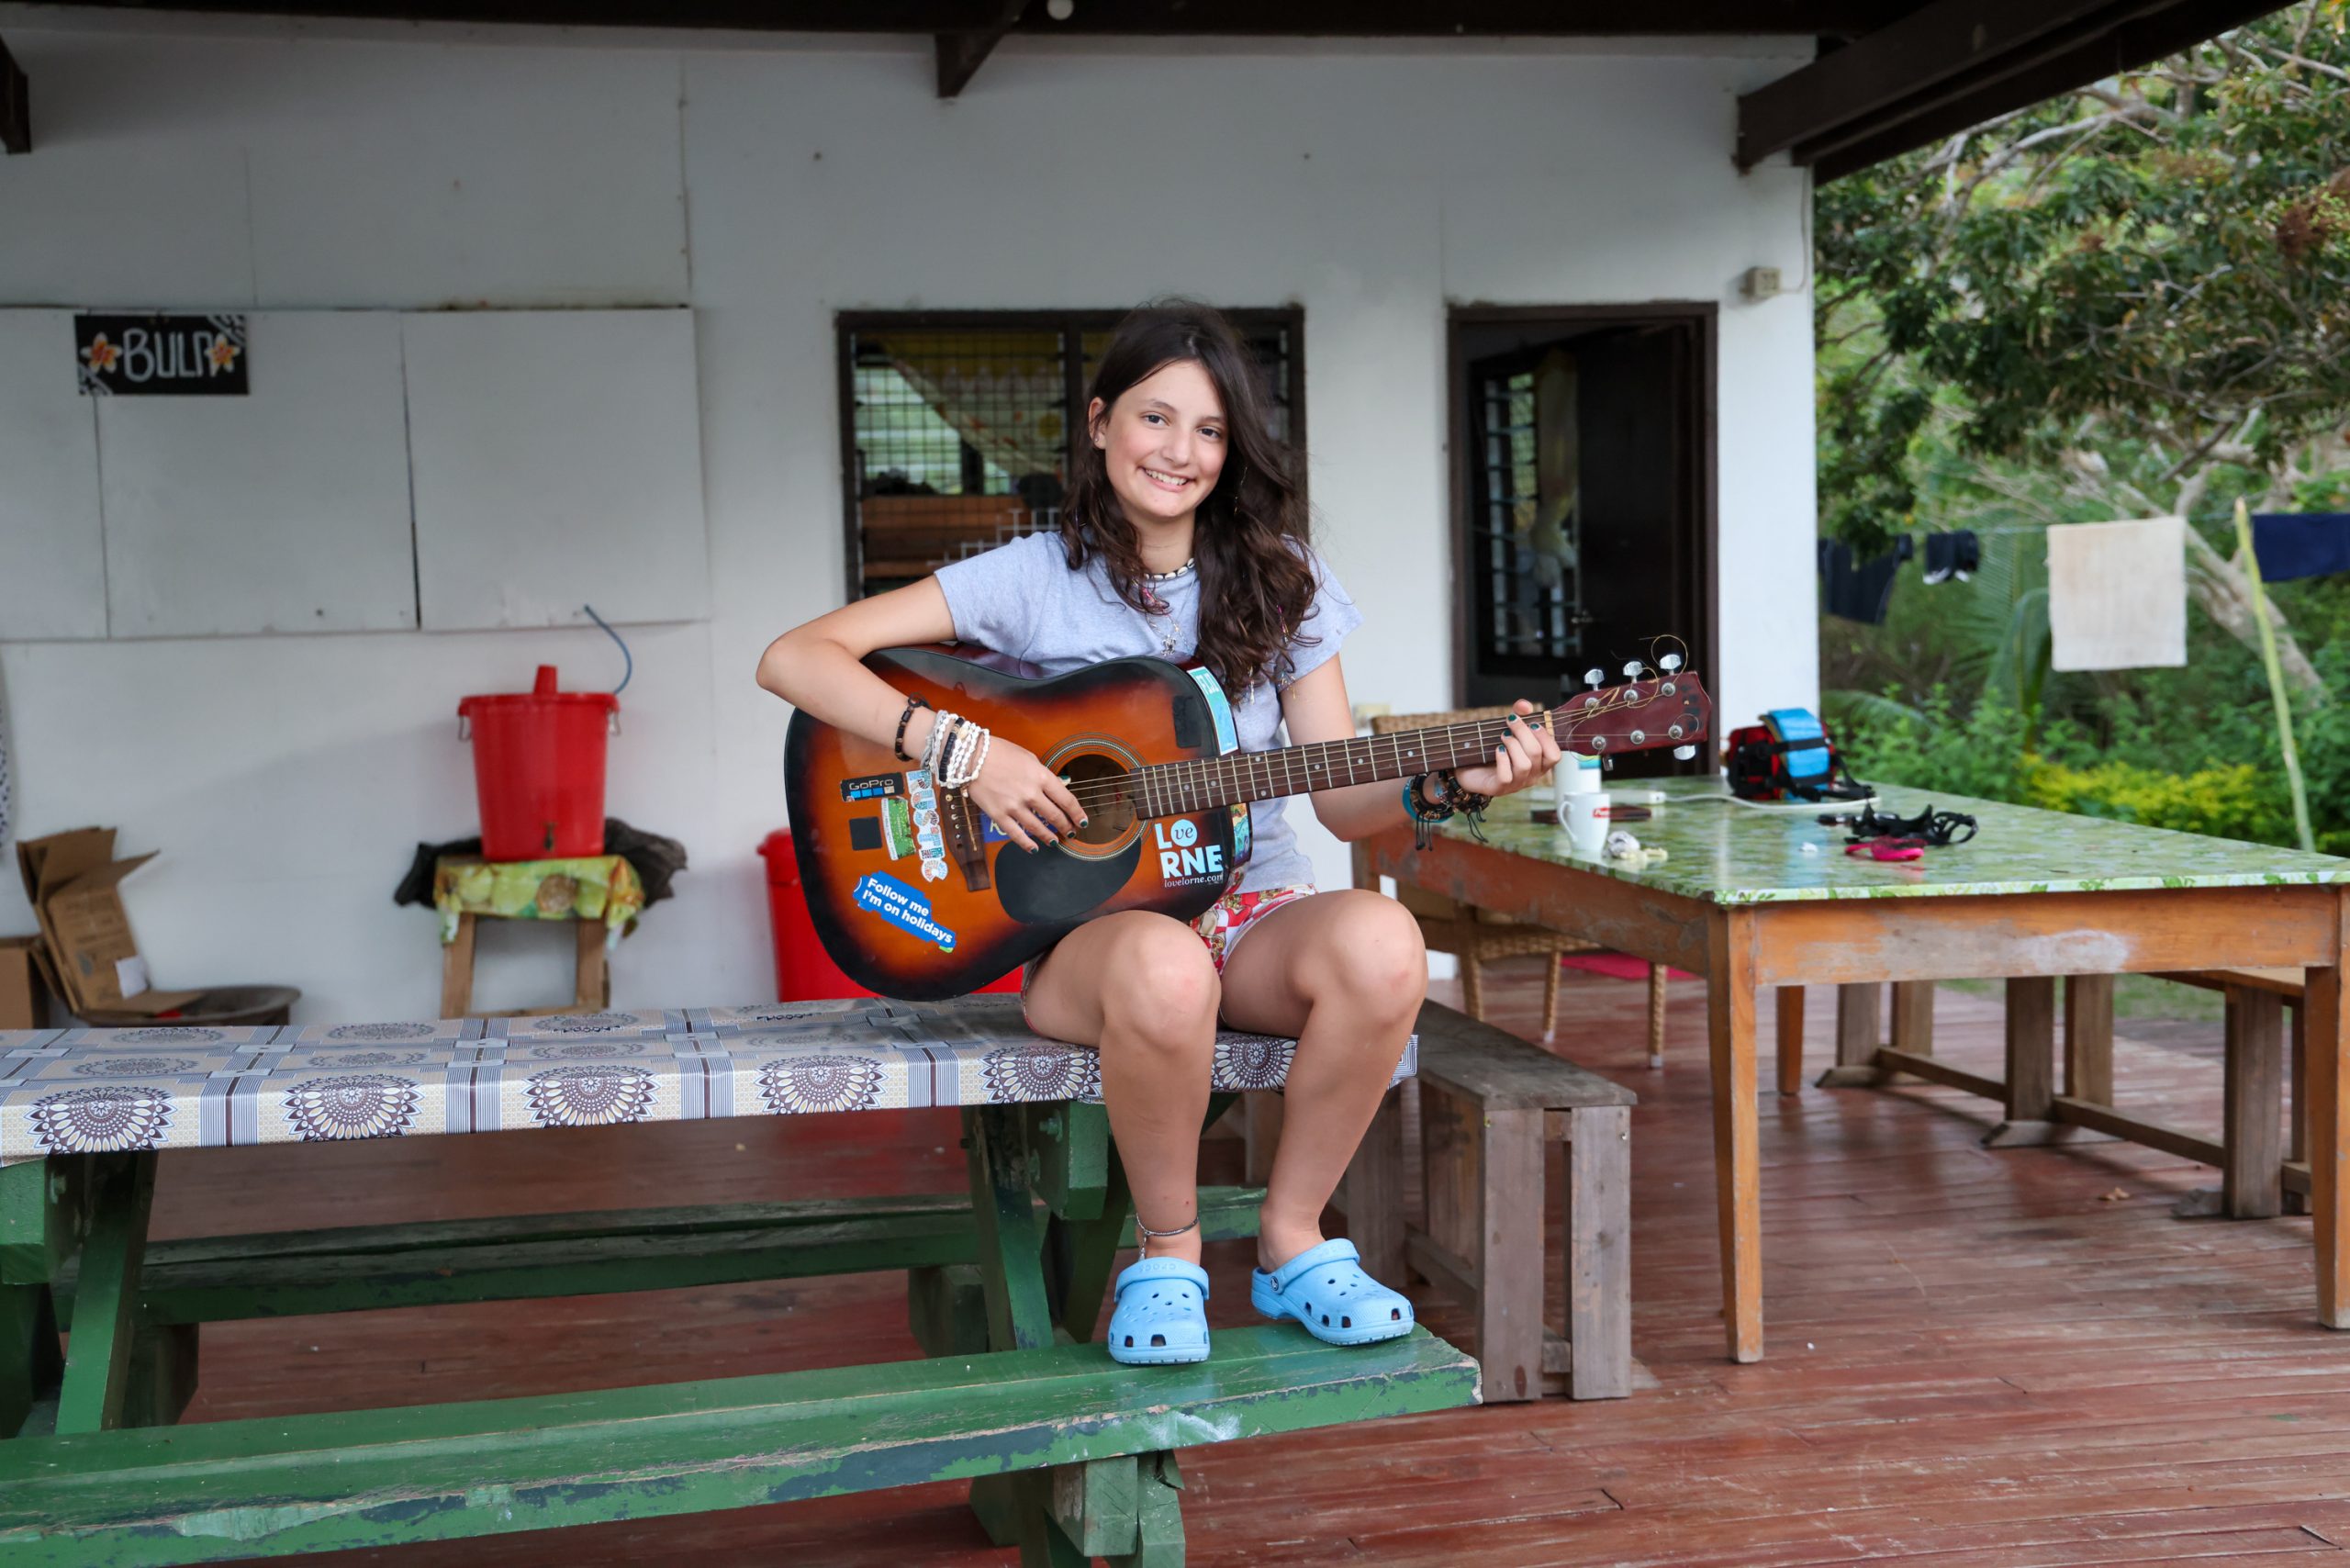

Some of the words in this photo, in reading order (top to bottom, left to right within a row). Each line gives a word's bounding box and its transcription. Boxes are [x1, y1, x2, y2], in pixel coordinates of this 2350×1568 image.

[849, 778, 894, 790] GoPro
[867, 878, 909, 905] Follow
[909, 901, 929, 917] me
[883, 902, 901, 916] on
[901, 909, 954, 944] holidays
